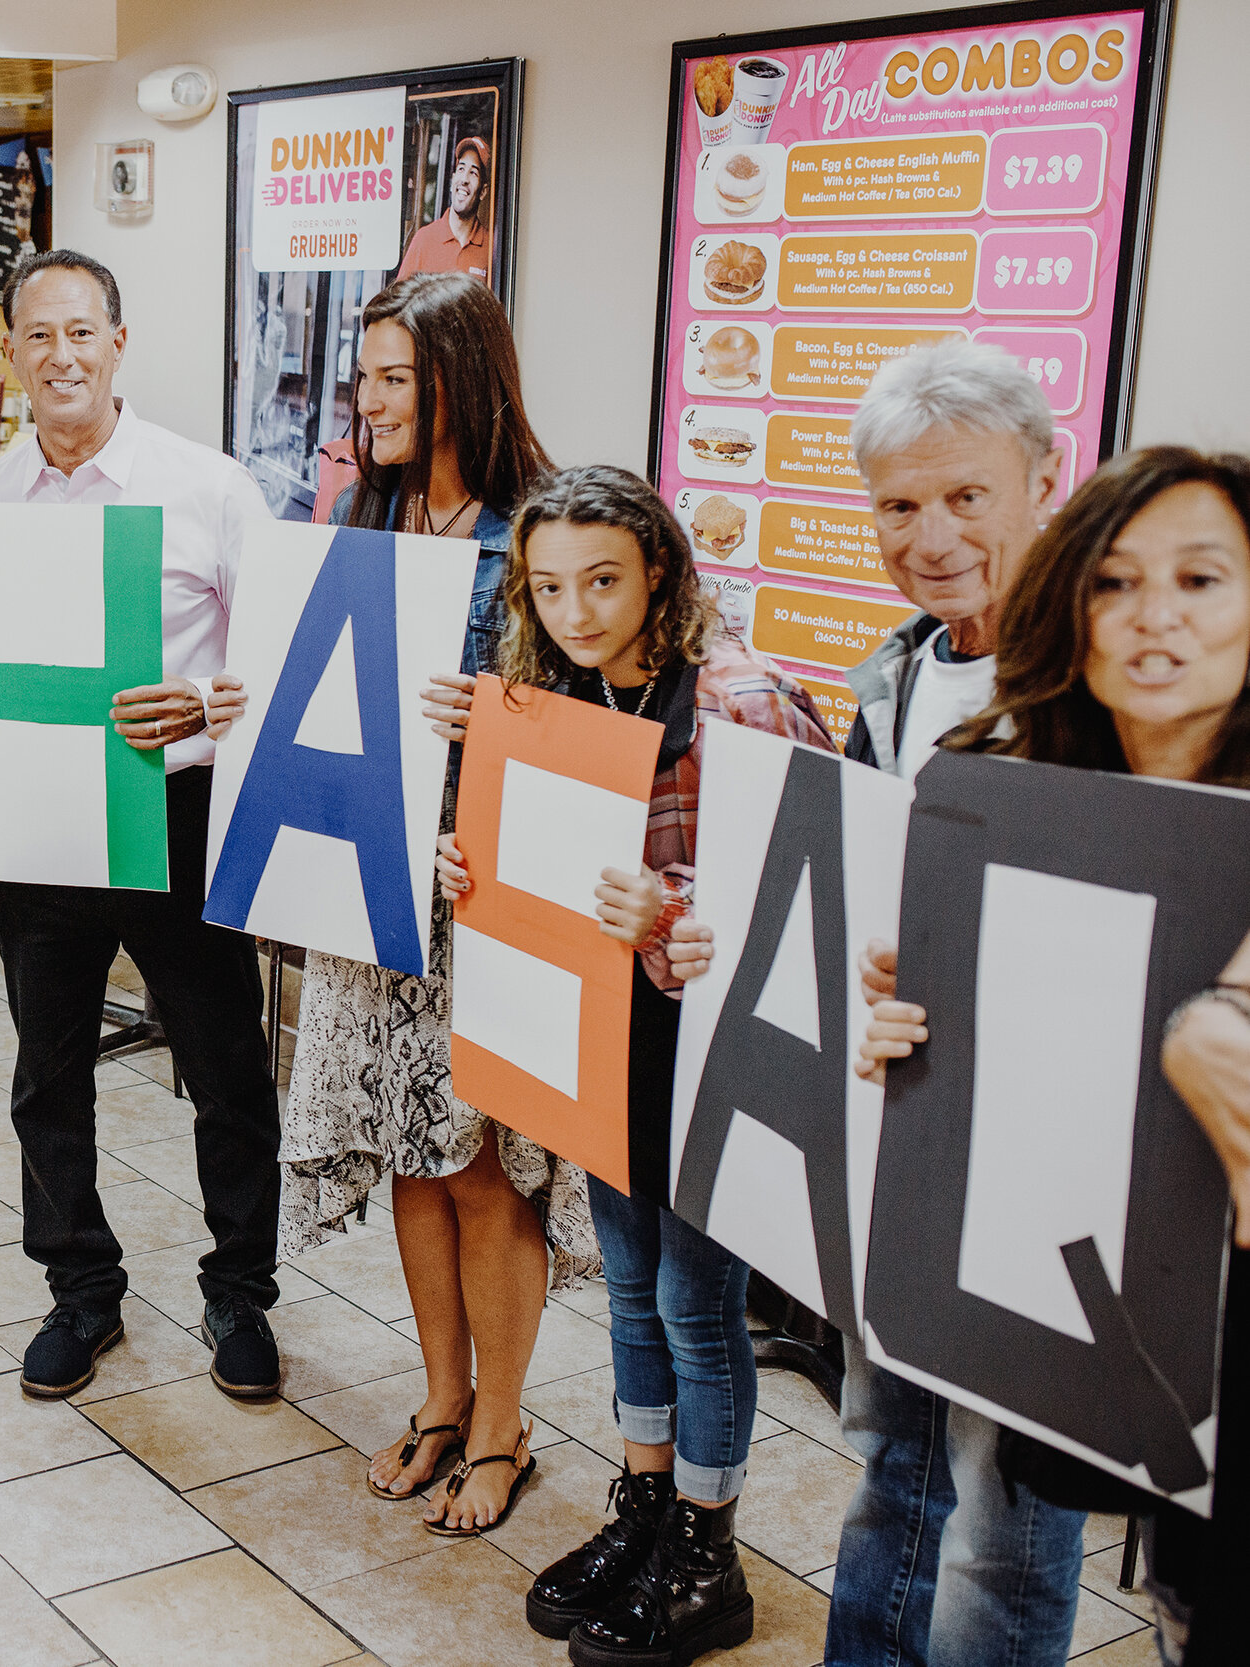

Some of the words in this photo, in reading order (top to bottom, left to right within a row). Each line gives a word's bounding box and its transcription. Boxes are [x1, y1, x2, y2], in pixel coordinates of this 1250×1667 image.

[884, 29, 1124, 99] COMBOS
[789, 41, 847, 108] All
[822, 76, 889, 135] Day
[881, 112, 907, 125] (Latte
[909, 109, 966, 123] substitutions
[969, 104, 1010, 119] available
[1012, 104, 1022, 115] at
[1024, 103, 1036, 113] an
[1039, 98, 1088, 112] additional
[1091, 95, 1118, 108] cost)
[271, 126, 394, 172] DUNKIN'
[701, 153, 710, 171] 1.
[791, 160, 818, 172] Ham,
[822, 158, 841, 172] Egg
[844, 156, 852, 169] &
[855, 155, 894, 169] Cheese
[898, 153, 939, 168] English
[942, 150, 980, 164] Muffin
[823, 175, 844, 186] With
[846, 175, 852, 185] 6
[854, 176, 868, 188] pc.
[871, 174, 893, 184] Hash
[896, 172, 930, 183] Browns
[933, 171, 940, 181] &
[1004, 154, 1083, 189] $7.39
[262, 168, 392, 206] DELIVERS
[802, 192, 837, 203] Medium
[839, 191, 855, 201] Hot
[857, 190, 886, 201] Coffee
[888, 188, 894, 200] /
[895, 189, 910, 199] Tea
[913, 187, 935, 200] (510
[937, 186, 961, 199] Cal.)
[292, 220, 318, 228] ORDER
[323, 219, 341, 227] NOW
[345, 218, 357, 226] ON
[290, 234, 358, 258] GRUBHUB
[695, 240, 706, 257] 2.
[787, 251, 833, 265] Sausage,
[836, 251, 855, 265] Egg
[858, 250, 866, 263] &
[869, 249, 909, 263] Cheese
[912, 249, 968, 262] Croissant
[816, 268, 836, 278] With
[838, 268, 844, 278] 6
[846, 269, 860, 280] pc.
[863, 268, 885, 278] Hash
[888, 267, 921, 278] Browns
[924, 267, 931, 278] &
[994, 256, 1073, 288] $7.59
[793, 284, 828, 294] Medium
[830, 283, 846, 294] Hot
[848, 284, 877, 294] Coffee
[878, 283, 884, 295] /
[885, 284, 901, 294] Tea
[903, 283, 927, 295] (850
[930, 283, 954, 296] Cal.)
[689, 325, 701, 342] 3.
[795, 341, 830, 355] Bacon,
[833, 342, 853, 356] Egg
[856, 342, 864, 355] &
[866, 343, 906, 356] Cheese
[809, 359, 829, 369] With
[831, 359, 837, 369] 6
[839, 360, 852, 371] pc.
[855, 360, 877, 371] Hash
[787, 373, 821, 384] Medium
[823, 375, 839, 384] Hot
[841, 375, 870, 386] Coffee
[685, 410, 696, 427] 4.
[791, 429, 823, 442] Power
[802, 447, 821, 457] With
[823, 449, 829, 458] 6
[832, 451, 844, 461] pc.
[781, 460, 813, 472] Medium
[816, 463, 831, 473] Hot
[833, 464, 860, 476] Coffee
[679, 493, 690, 509] 5.
[790, 517, 806, 532] Big
[809, 519, 816, 530] &
[819, 520, 859, 536] Toasted
[795, 534, 814, 545] With
[816, 537, 822, 546] 6
[824, 539, 837, 549] pc.
[840, 540, 861, 551] Hash
[775, 546, 807, 559] Medium
[809, 551, 825, 561] Hot
[826, 554, 854, 566] Coffee
[855, 556, 860, 567] /
[862, 558, 876, 568] Tea
[723, 579, 752, 593] Combo
[774, 608, 789, 622] 50
[791, 611, 844, 631] Munchkins
[846, 620, 854, 633] &
[857, 622, 877, 636] Box
[879, 626, 892, 638] of
[814, 630, 842, 645] (3600
[845, 636, 866, 650] Cal.)
[812, 694, 832, 707] with
[828, 714, 835, 726] &
[203, 531, 423, 975] A
[452, 672, 666, 1197] S
[672, 746, 863, 1340] A
